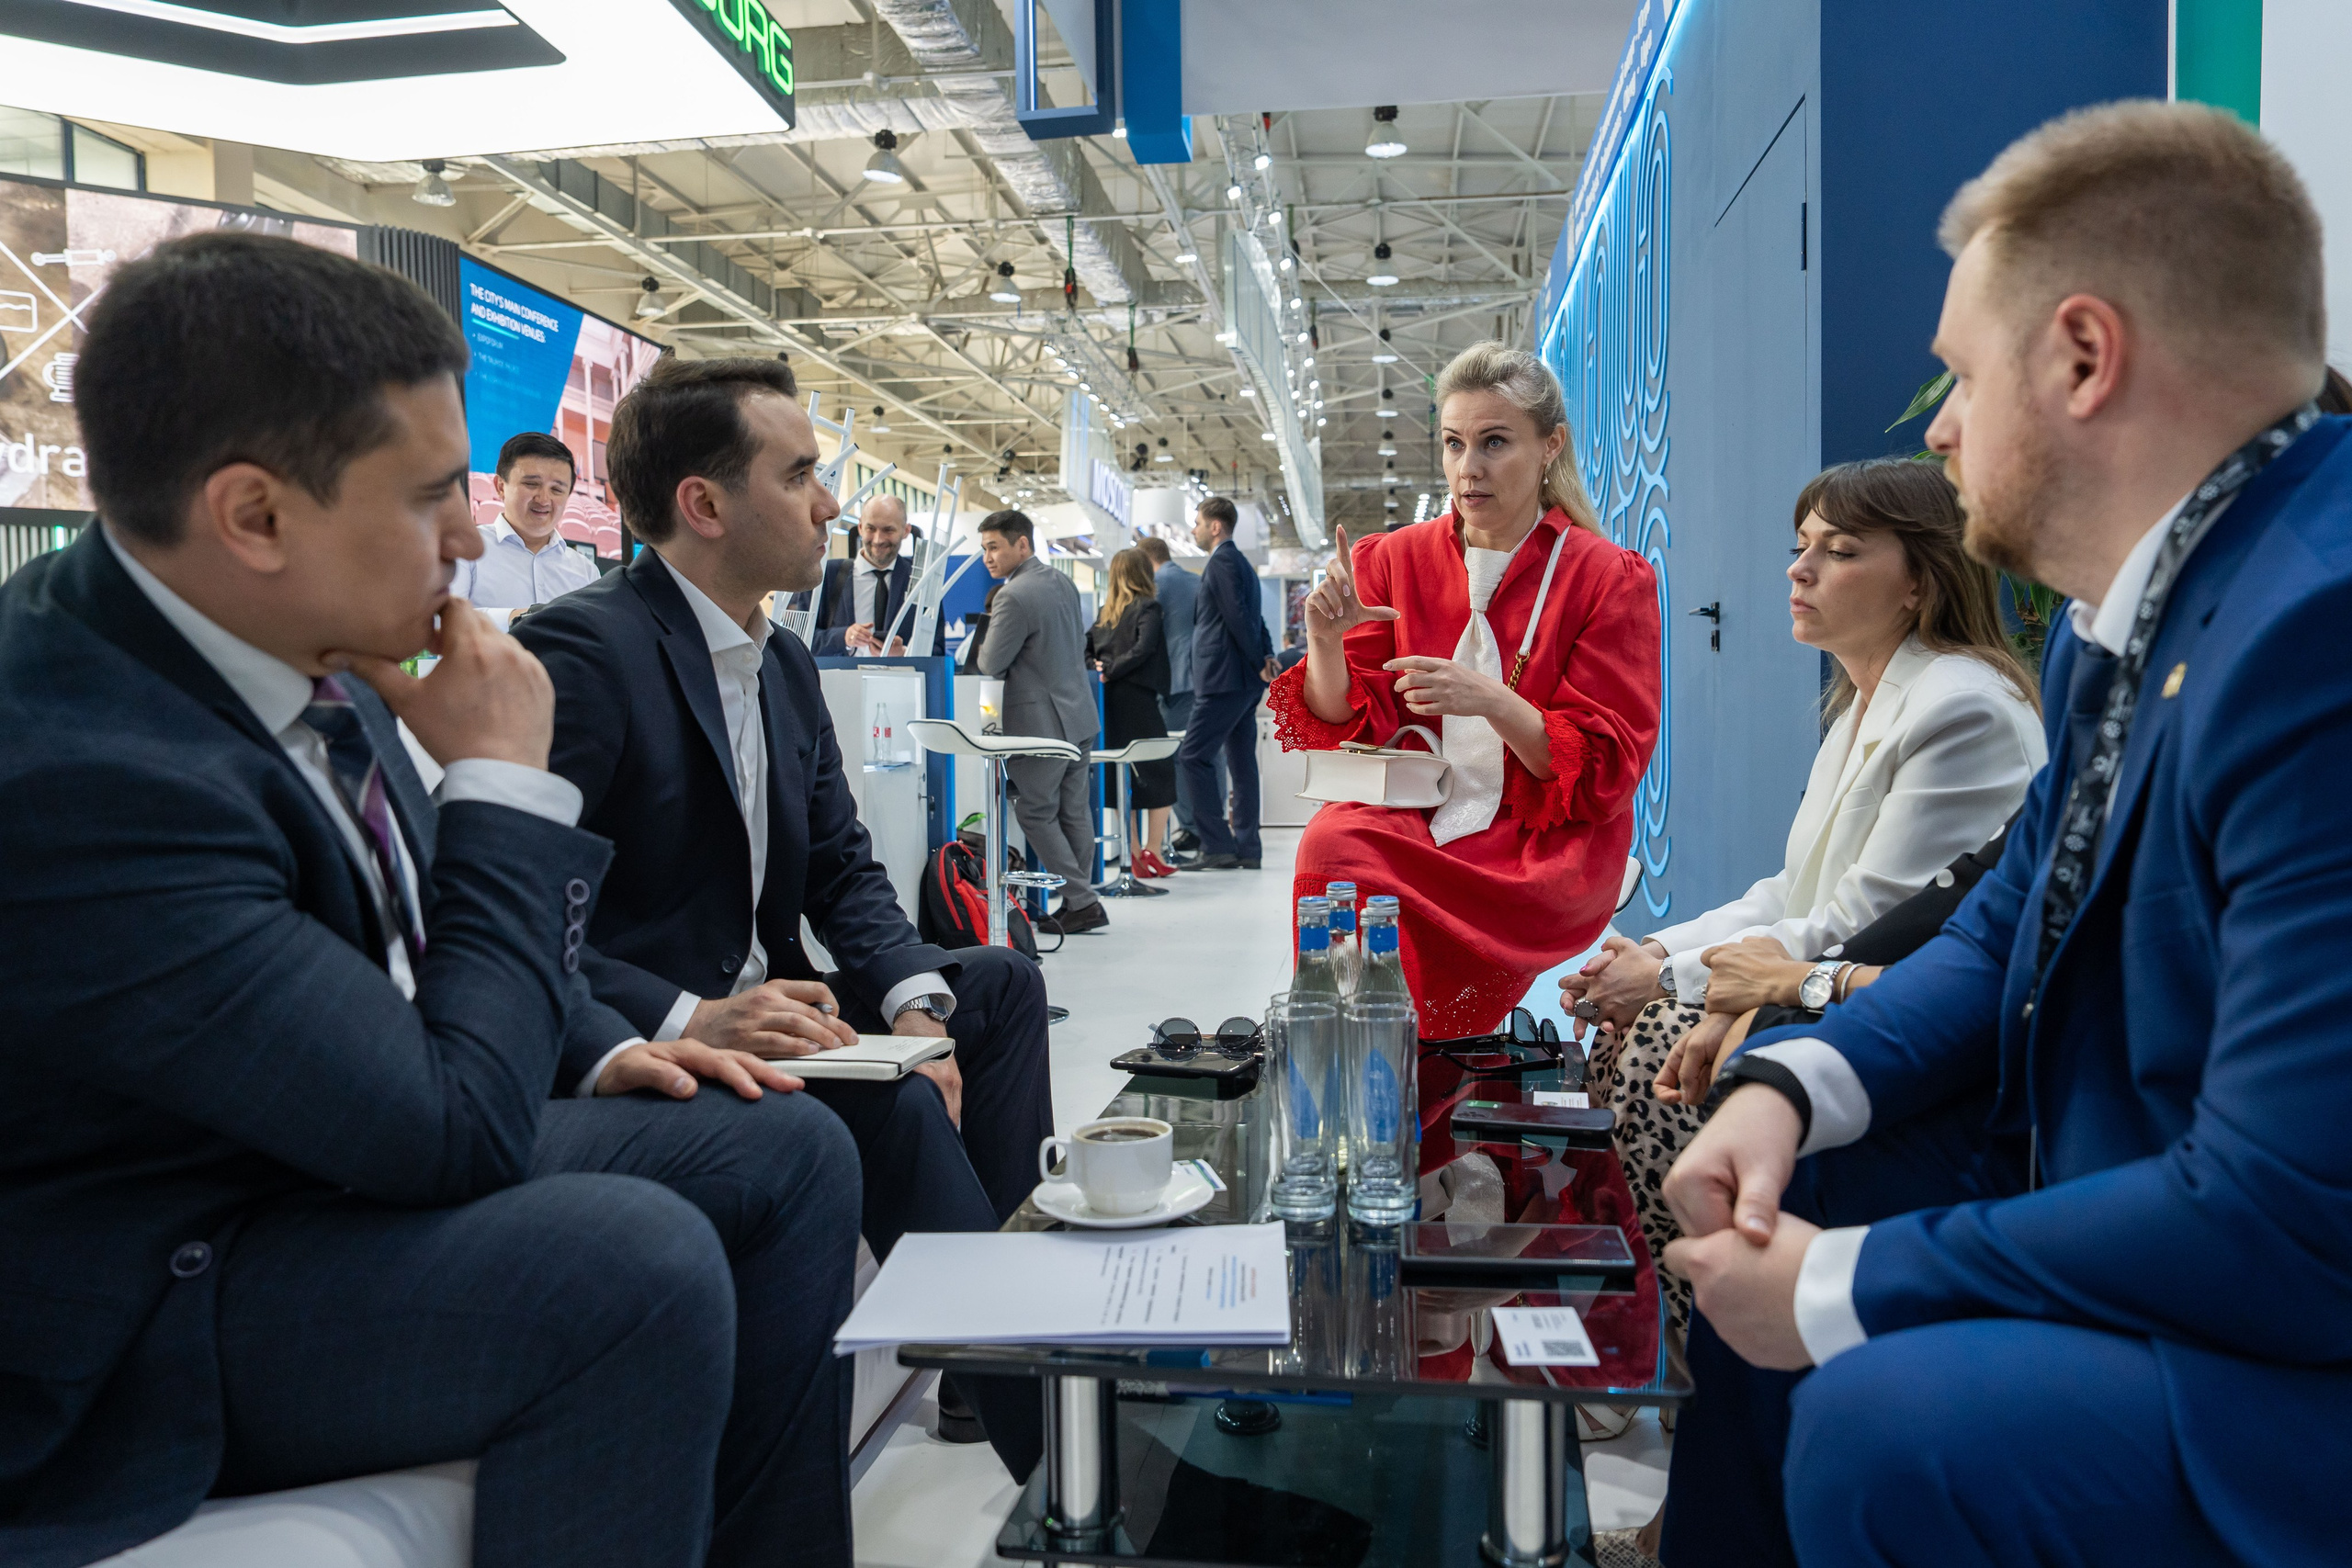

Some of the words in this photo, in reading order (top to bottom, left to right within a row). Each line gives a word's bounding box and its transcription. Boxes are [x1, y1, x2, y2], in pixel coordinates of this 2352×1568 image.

[469, 282, 484, 301] THE
[484, 289, 504, 309] CITY'S
[504, 299, 521, 316] MAIN
[521, 306, 559, 333] CONFERENCE
[470, 302, 485, 319] AND
[486, 308, 520, 333] EXHIBITION
